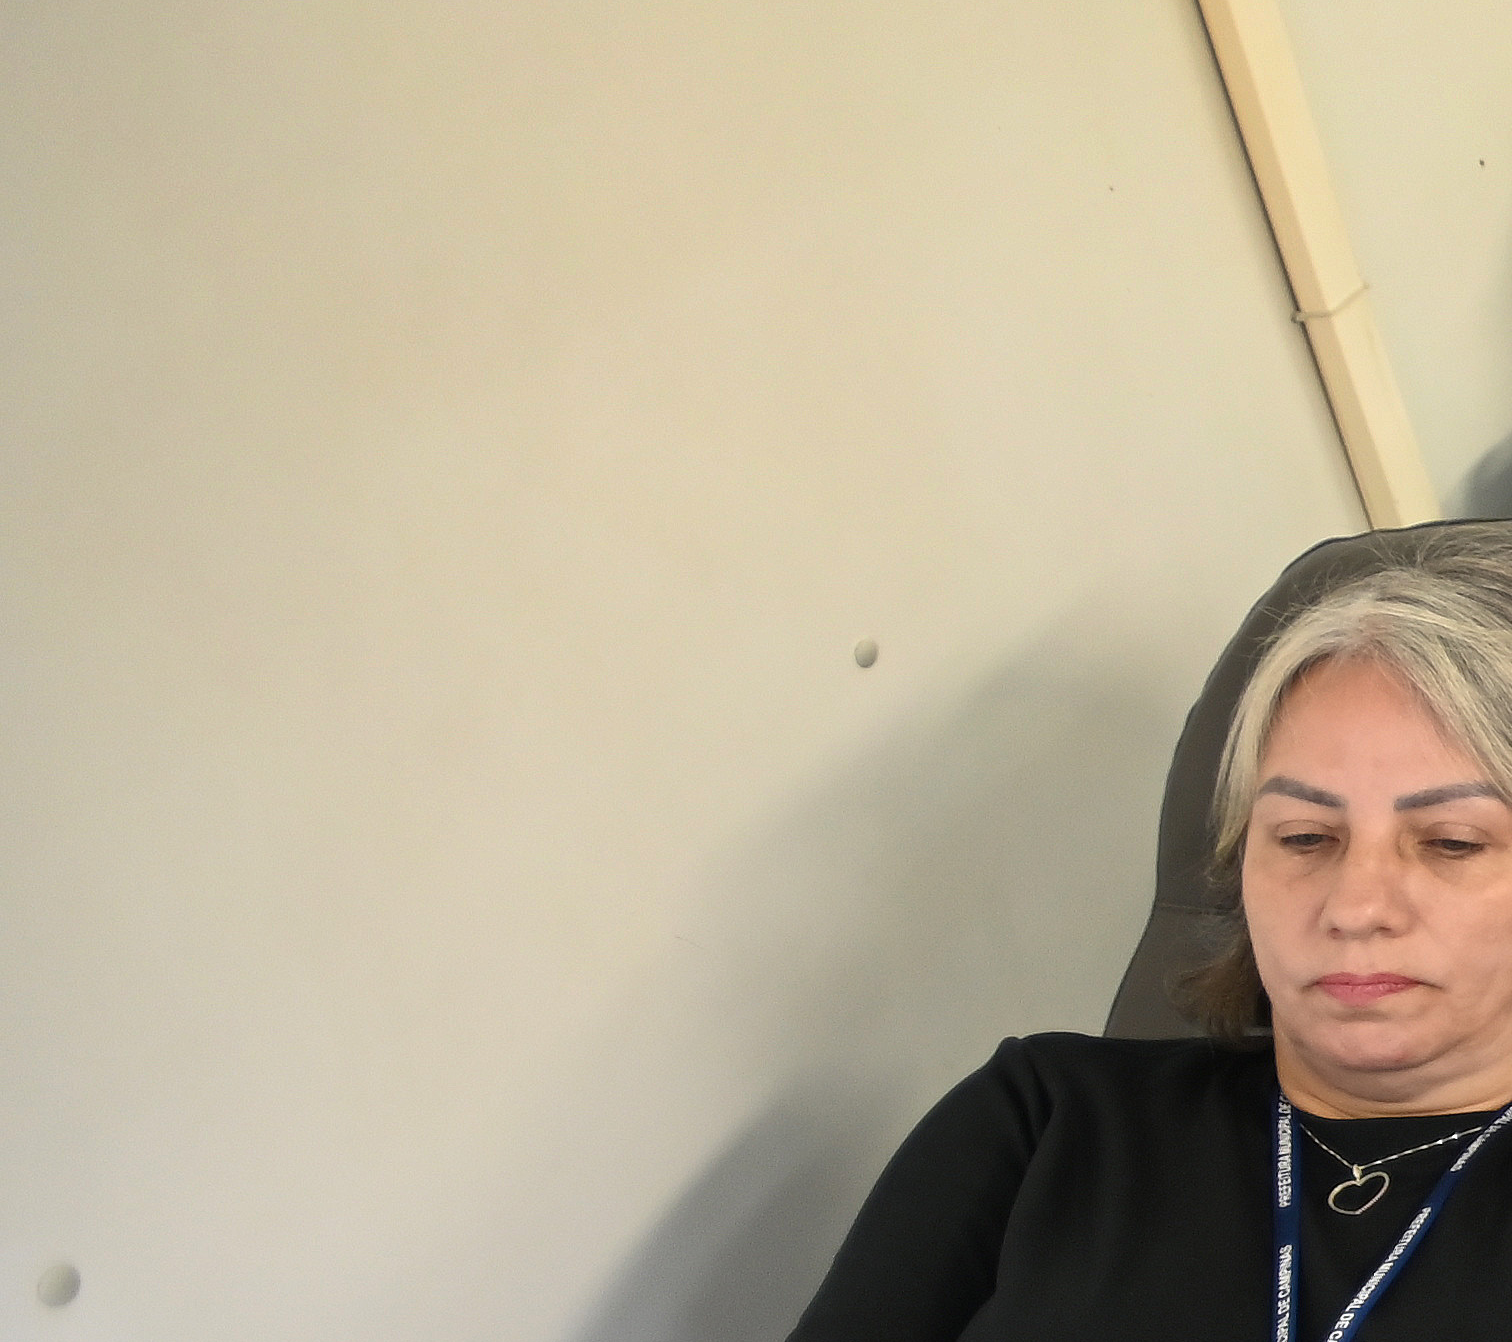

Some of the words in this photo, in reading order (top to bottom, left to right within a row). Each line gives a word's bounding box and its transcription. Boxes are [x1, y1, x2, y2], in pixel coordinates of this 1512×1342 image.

[1278, 1244, 1293, 1297] CAMPINAS
[1278, 1296, 1291, 1313] DE
[1334, 1312, 1354, 1329] DE
